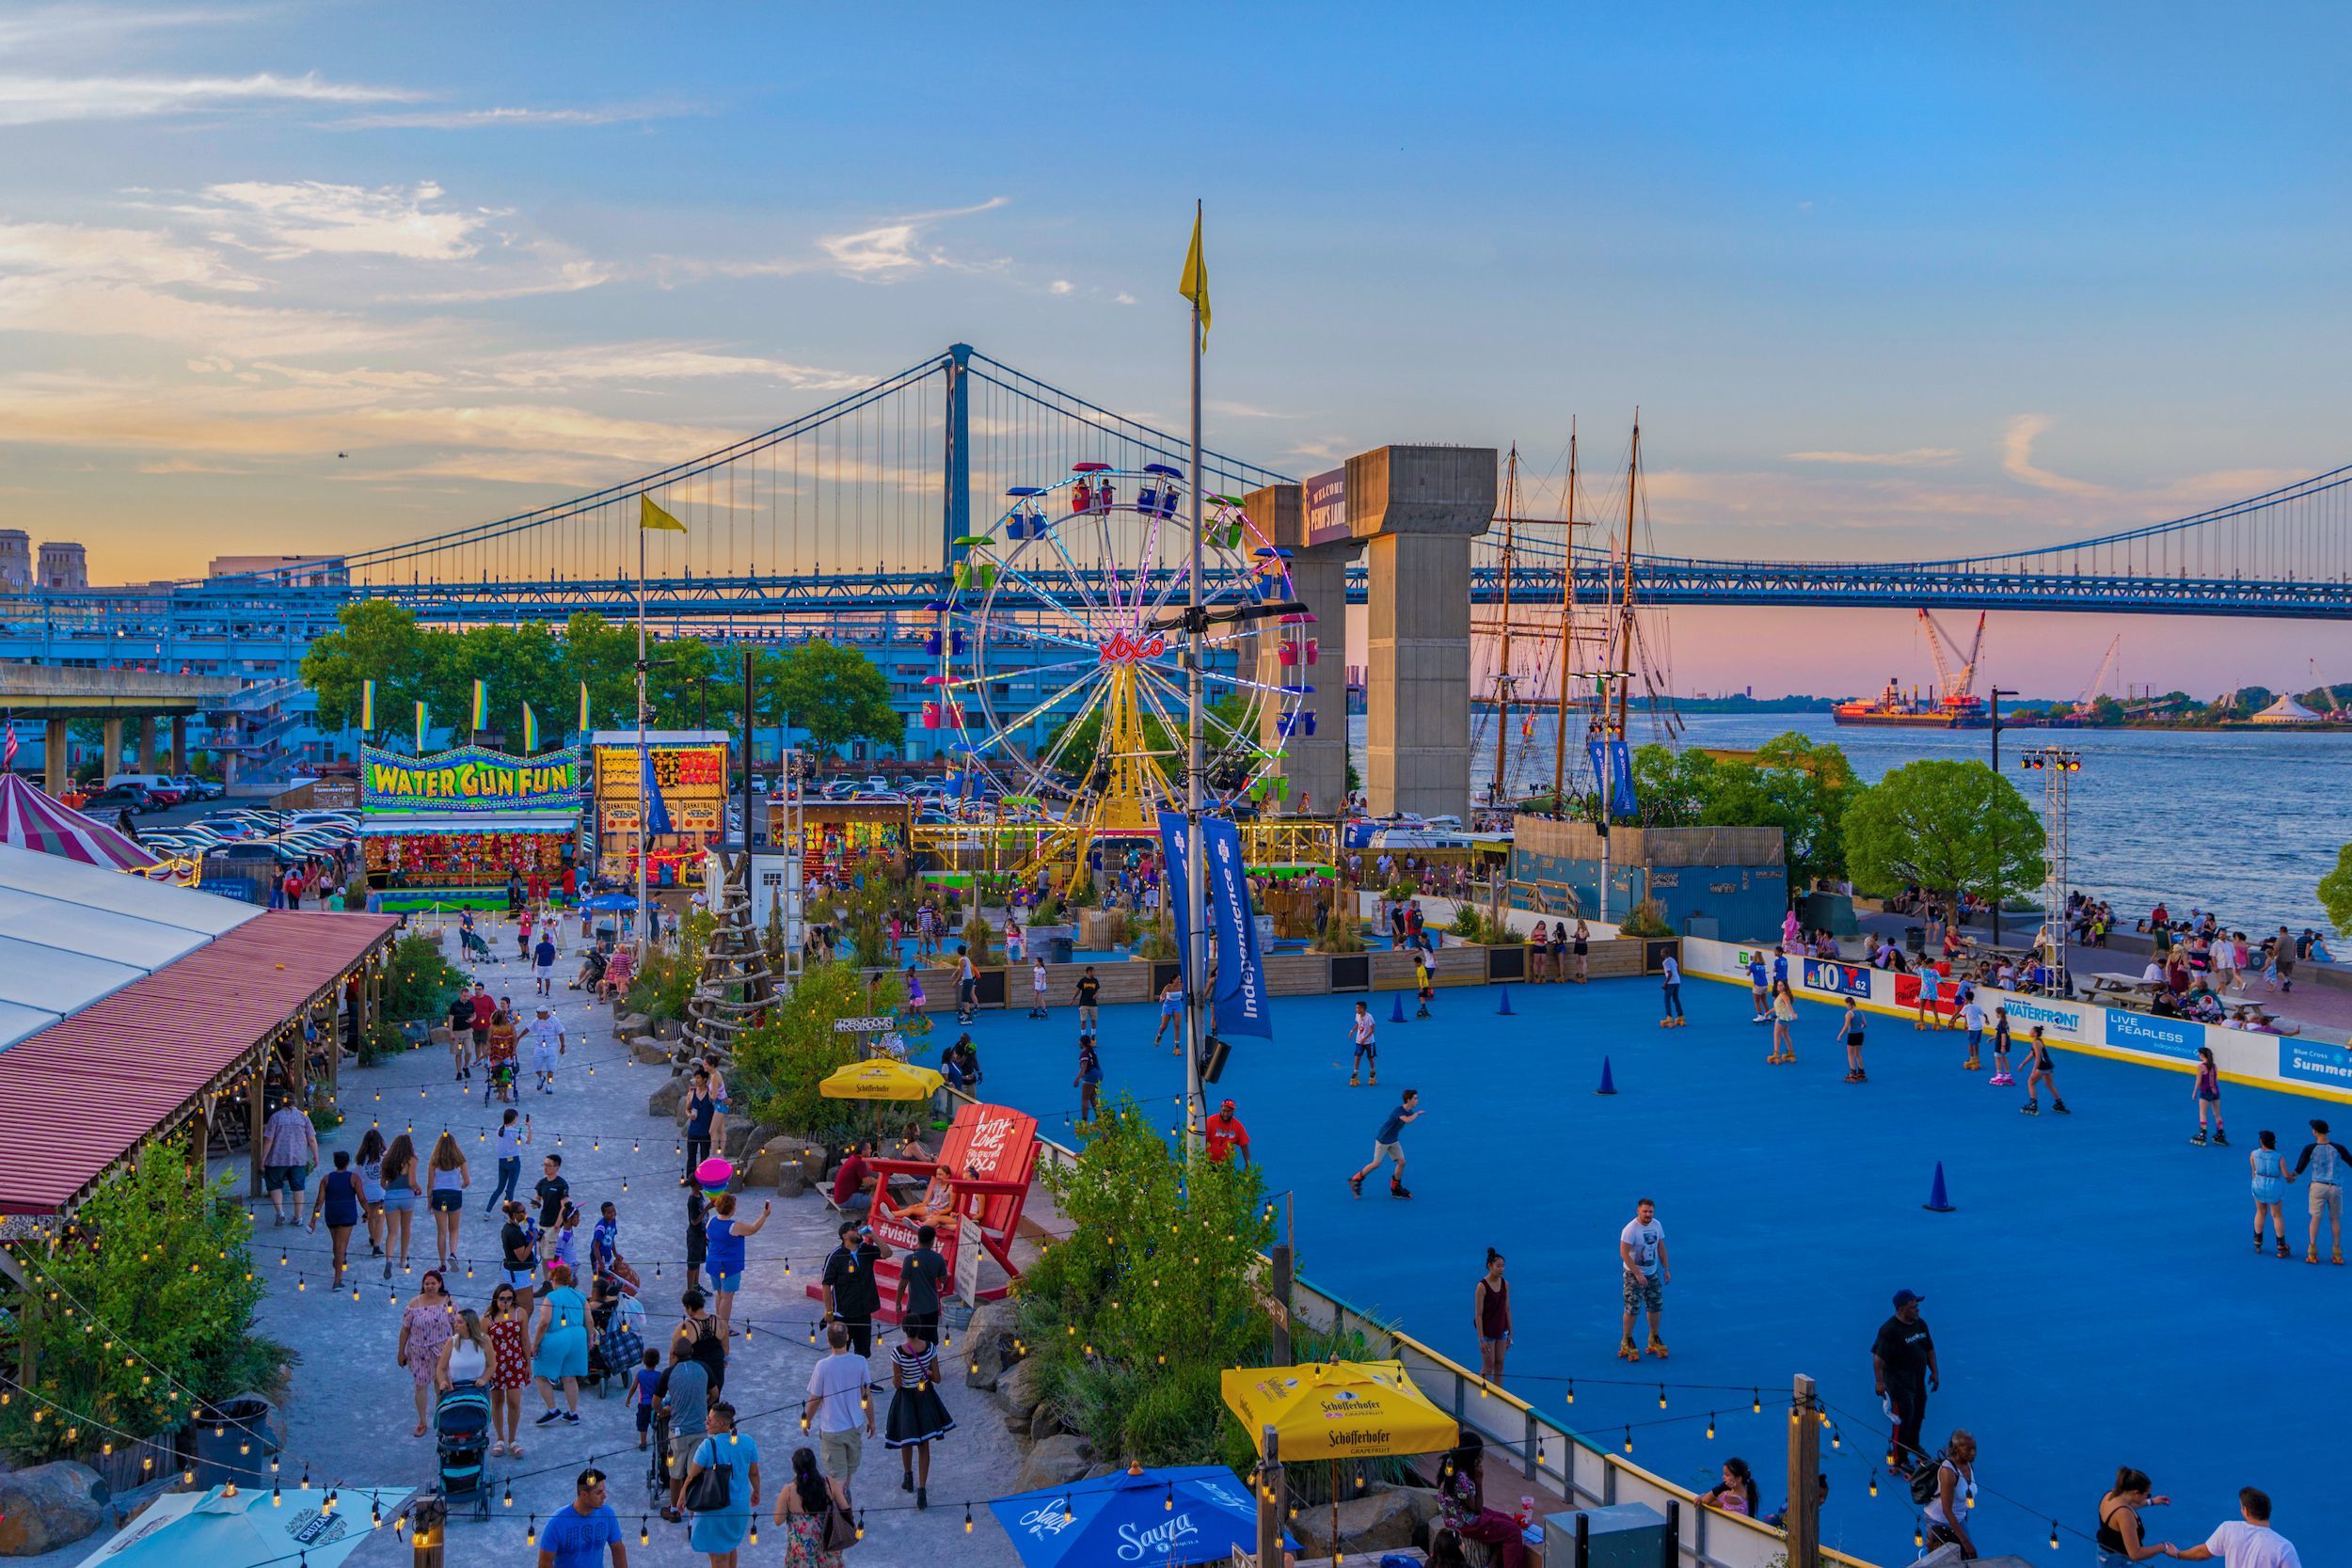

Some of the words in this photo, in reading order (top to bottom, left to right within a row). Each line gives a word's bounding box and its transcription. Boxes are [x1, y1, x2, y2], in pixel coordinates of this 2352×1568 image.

[1313, 481, 1343, 505] WELCOME
[1311, 504, 1330, 531] PENN'S
[373, 763, 456, 798] WATER
[459, 763, 515, 798] GUN
[517, 764, 568, 798] FUN
[607, 802, 640, 811] BASKETBALL
[645, 802, 677, 811] BBALL
[683, 802, 716, 811] BASKETBALL
[1216, 867, 1258, 1020] Independence
[1818, 963, 1839, 990] 10
[1843, 988, 1867, 997] TELEMUNDO
[1855, 980, 1867, 990] 62
[2004, 1002, 2079, 1028] WATERFRONT
[2110, 1015, 2138, 1026] LIVE
[844, 1018, 894, 1032] RESTROOMS
[2054, 1023, 2078, 1033] Corporation
[2118, 1024, 2184, 1043] FEARLESS
[2309, 1051, 2328, 1060] Cross
[879, 1223, 944, 1254] #visitply
[1320, 1400, 1382, 1412] Schöfferhofer
[1328, 1429, 1391, 1448] Schöfferhofer
[1117, 1512, 1199, 1561] Sauza
